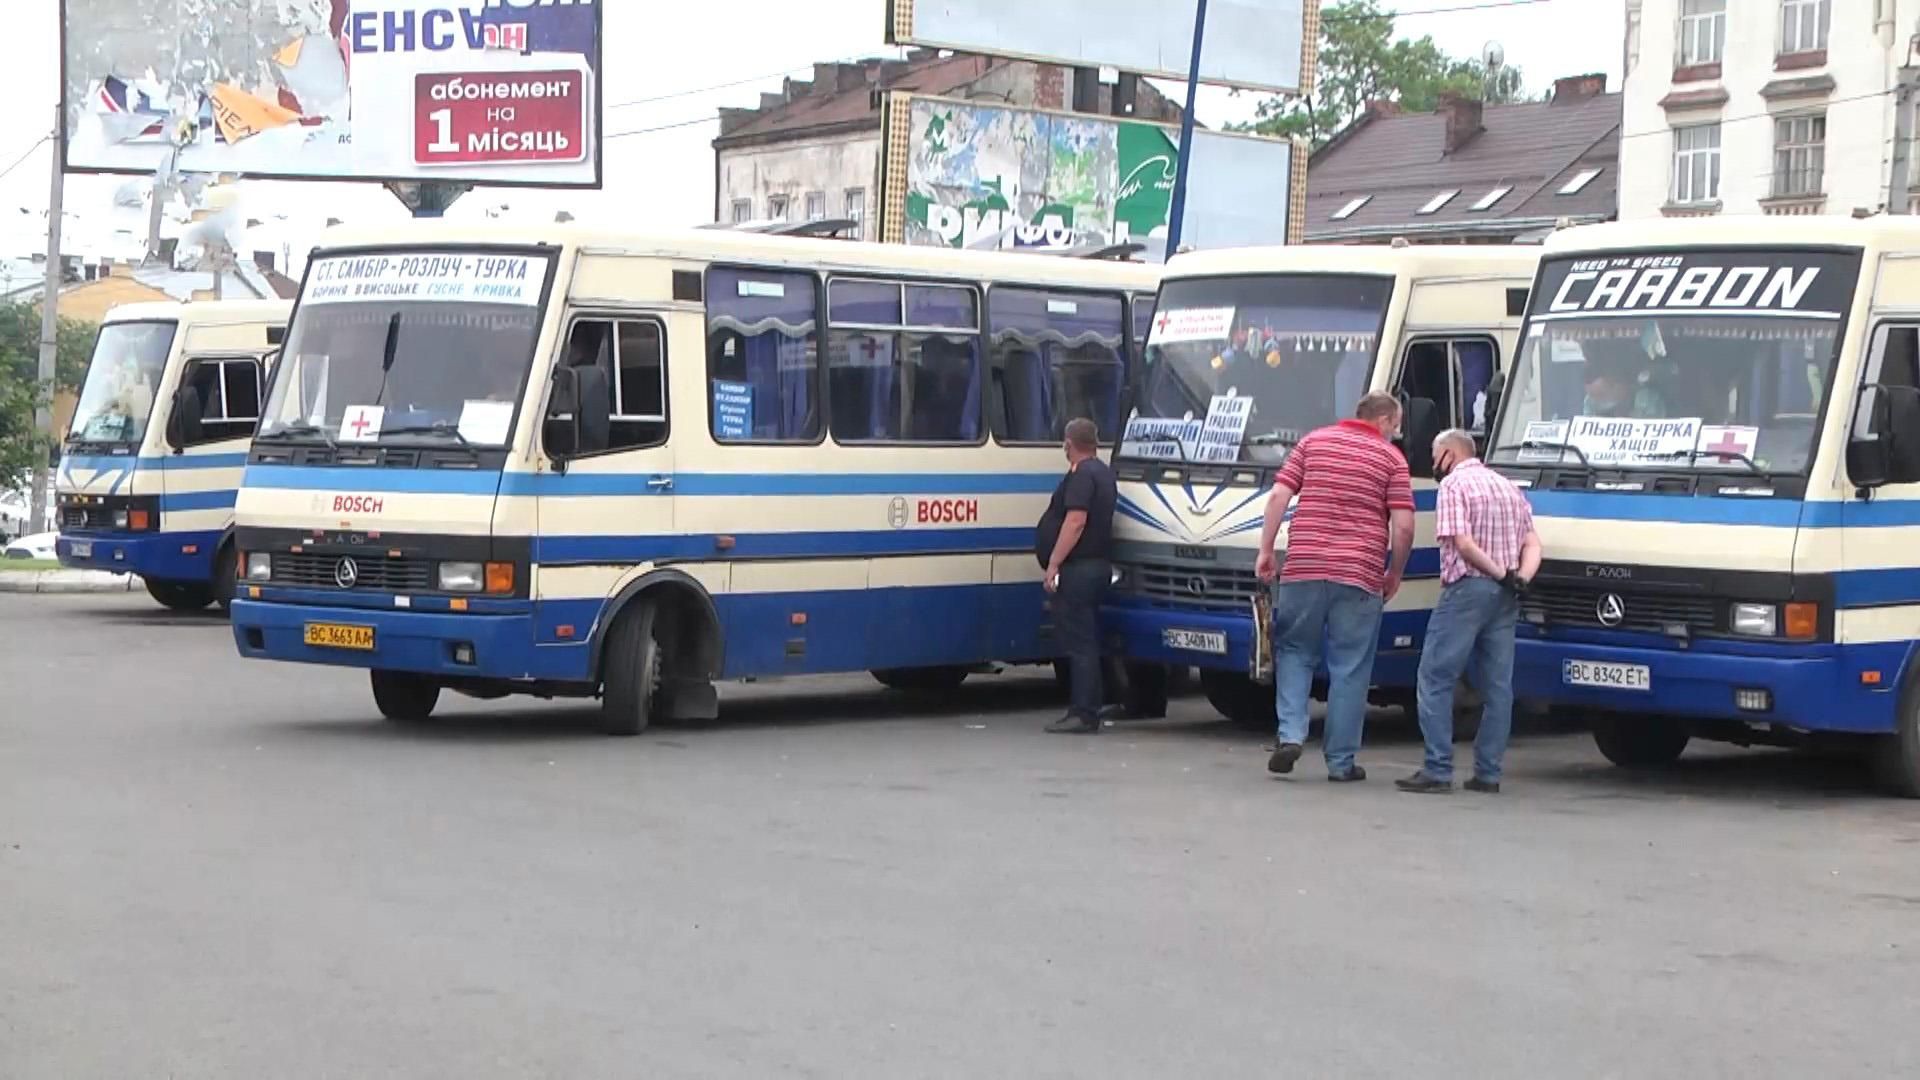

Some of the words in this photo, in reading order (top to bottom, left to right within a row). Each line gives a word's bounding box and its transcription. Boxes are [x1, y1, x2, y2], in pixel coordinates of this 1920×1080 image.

[430, 77, 571, 100] абонемент
[487, 106, 515, 121] на
[428, 108, 460, 153] 1
[468, 128, 569, 153] місяць
[1570, 258, 1608, 272] NEED
[1631, 256, 1684, 269] SPEED
[1609, 438, 1659, 452] ХАЩІВ
[333, 496, 383, 513] BOSCH
[917, 500, 978, 522] BOSCH
[329, 627, 354, 645] 3663
[1571, 664, 1591, 682] BC
[1594, 666, 1622, 685] 8342
